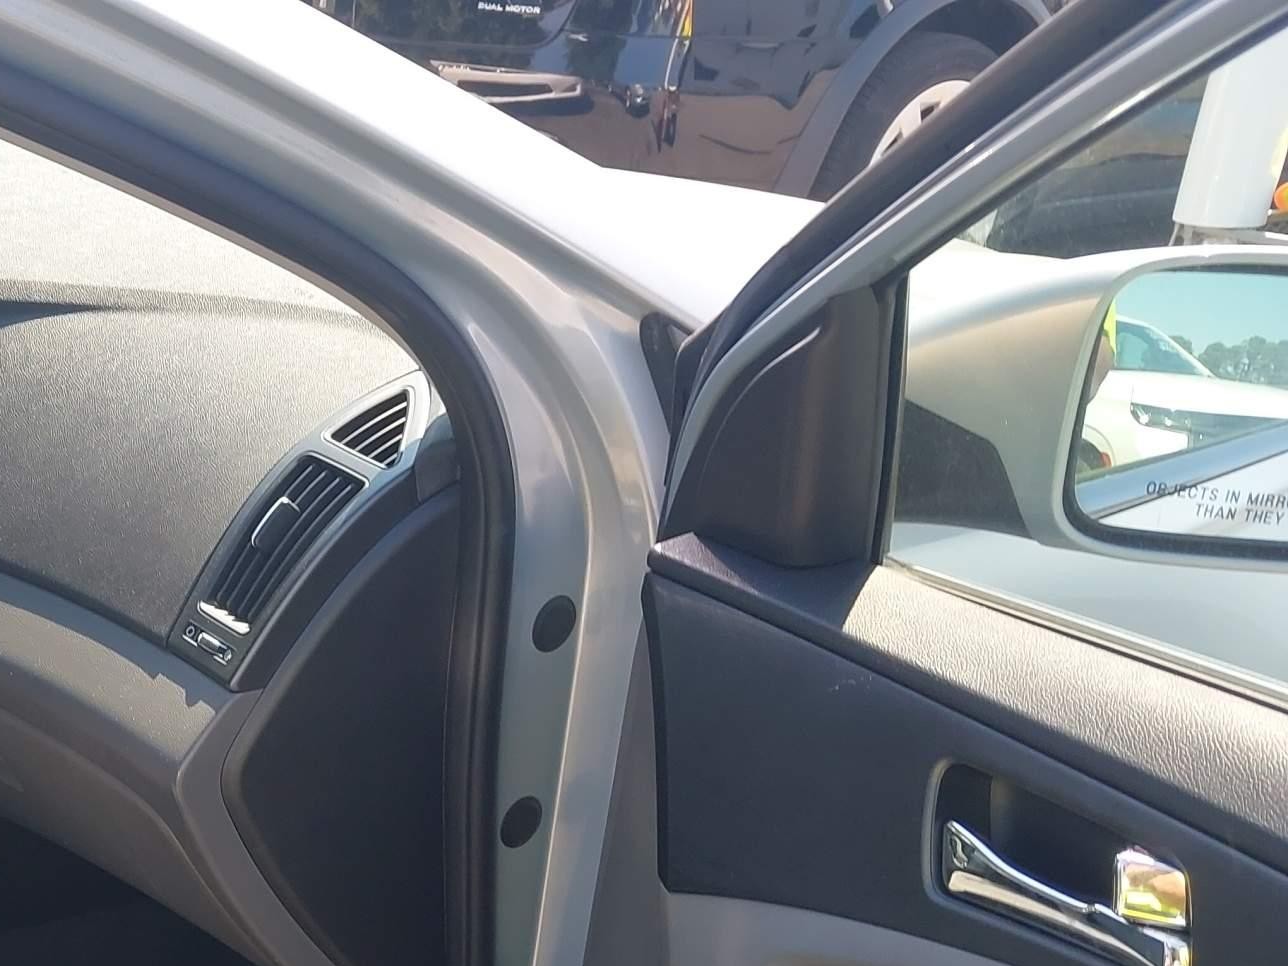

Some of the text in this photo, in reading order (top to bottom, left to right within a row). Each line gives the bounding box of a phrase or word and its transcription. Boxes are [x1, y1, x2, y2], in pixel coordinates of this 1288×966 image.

[477, 2, 541, 14] DUAL MOTOR
[1146, 480, 1288, 509] OBJECTS IN MIRR
[1195, 503, 1285, 526] THAN THEY
